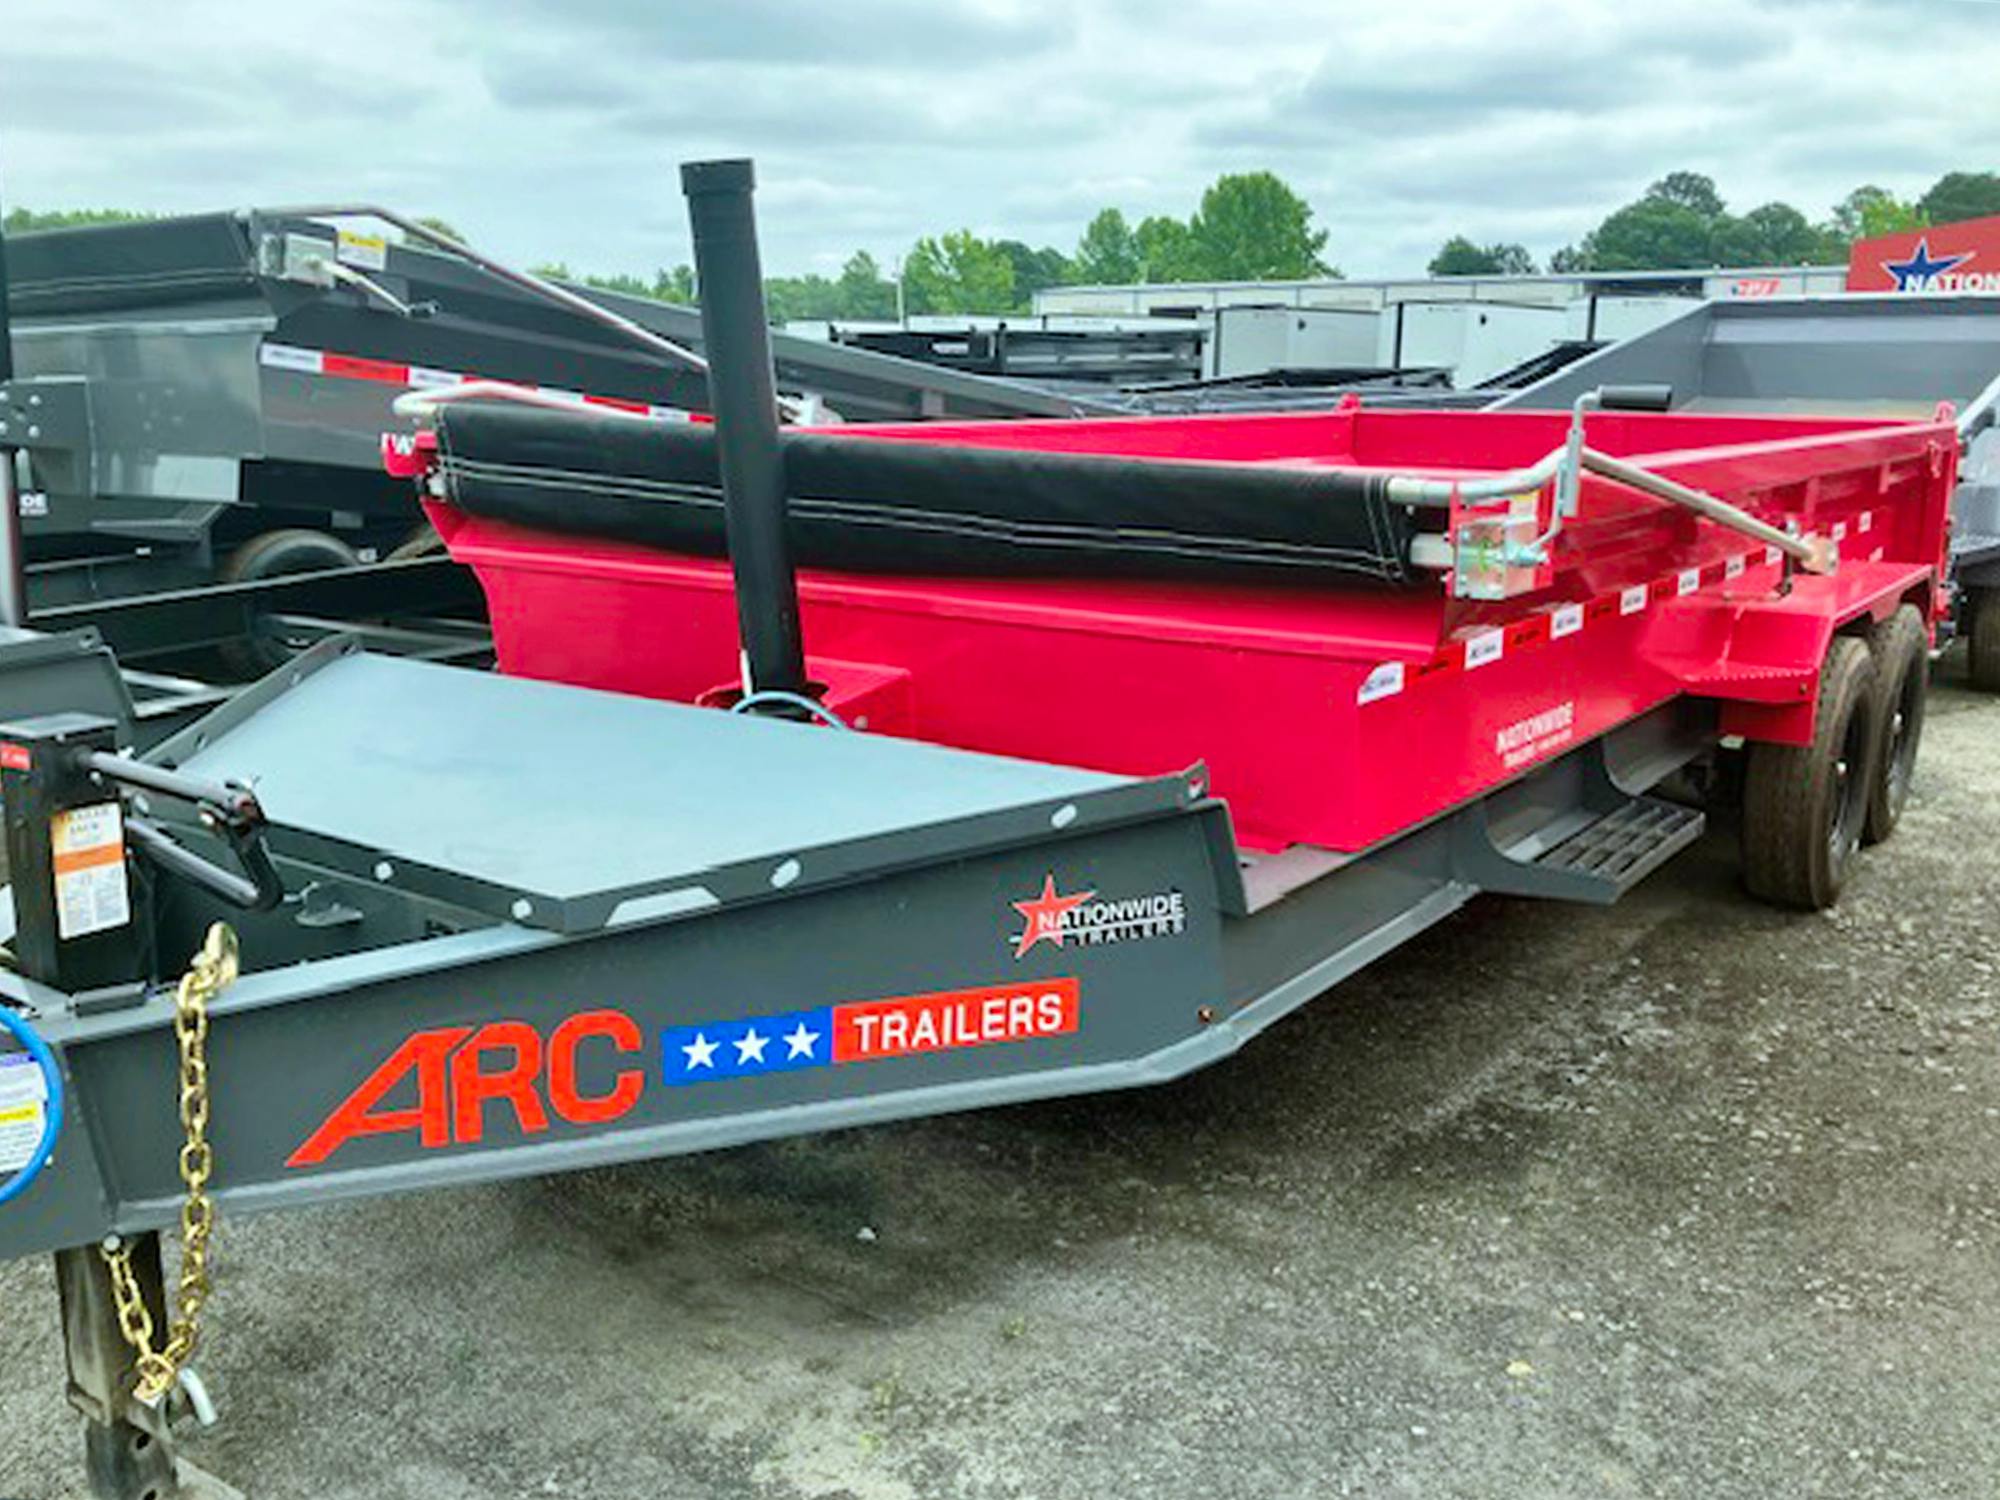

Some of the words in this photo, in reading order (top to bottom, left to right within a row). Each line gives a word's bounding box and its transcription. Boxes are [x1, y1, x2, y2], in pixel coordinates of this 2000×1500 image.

[1038, 893, 1184, 933] NATIONWIDE
[1076, 914, 1186, 946] TRAILERS
[284, 1009, 645, 1168] ARC
[852, 993, 1064, 1053] TRAILERS
